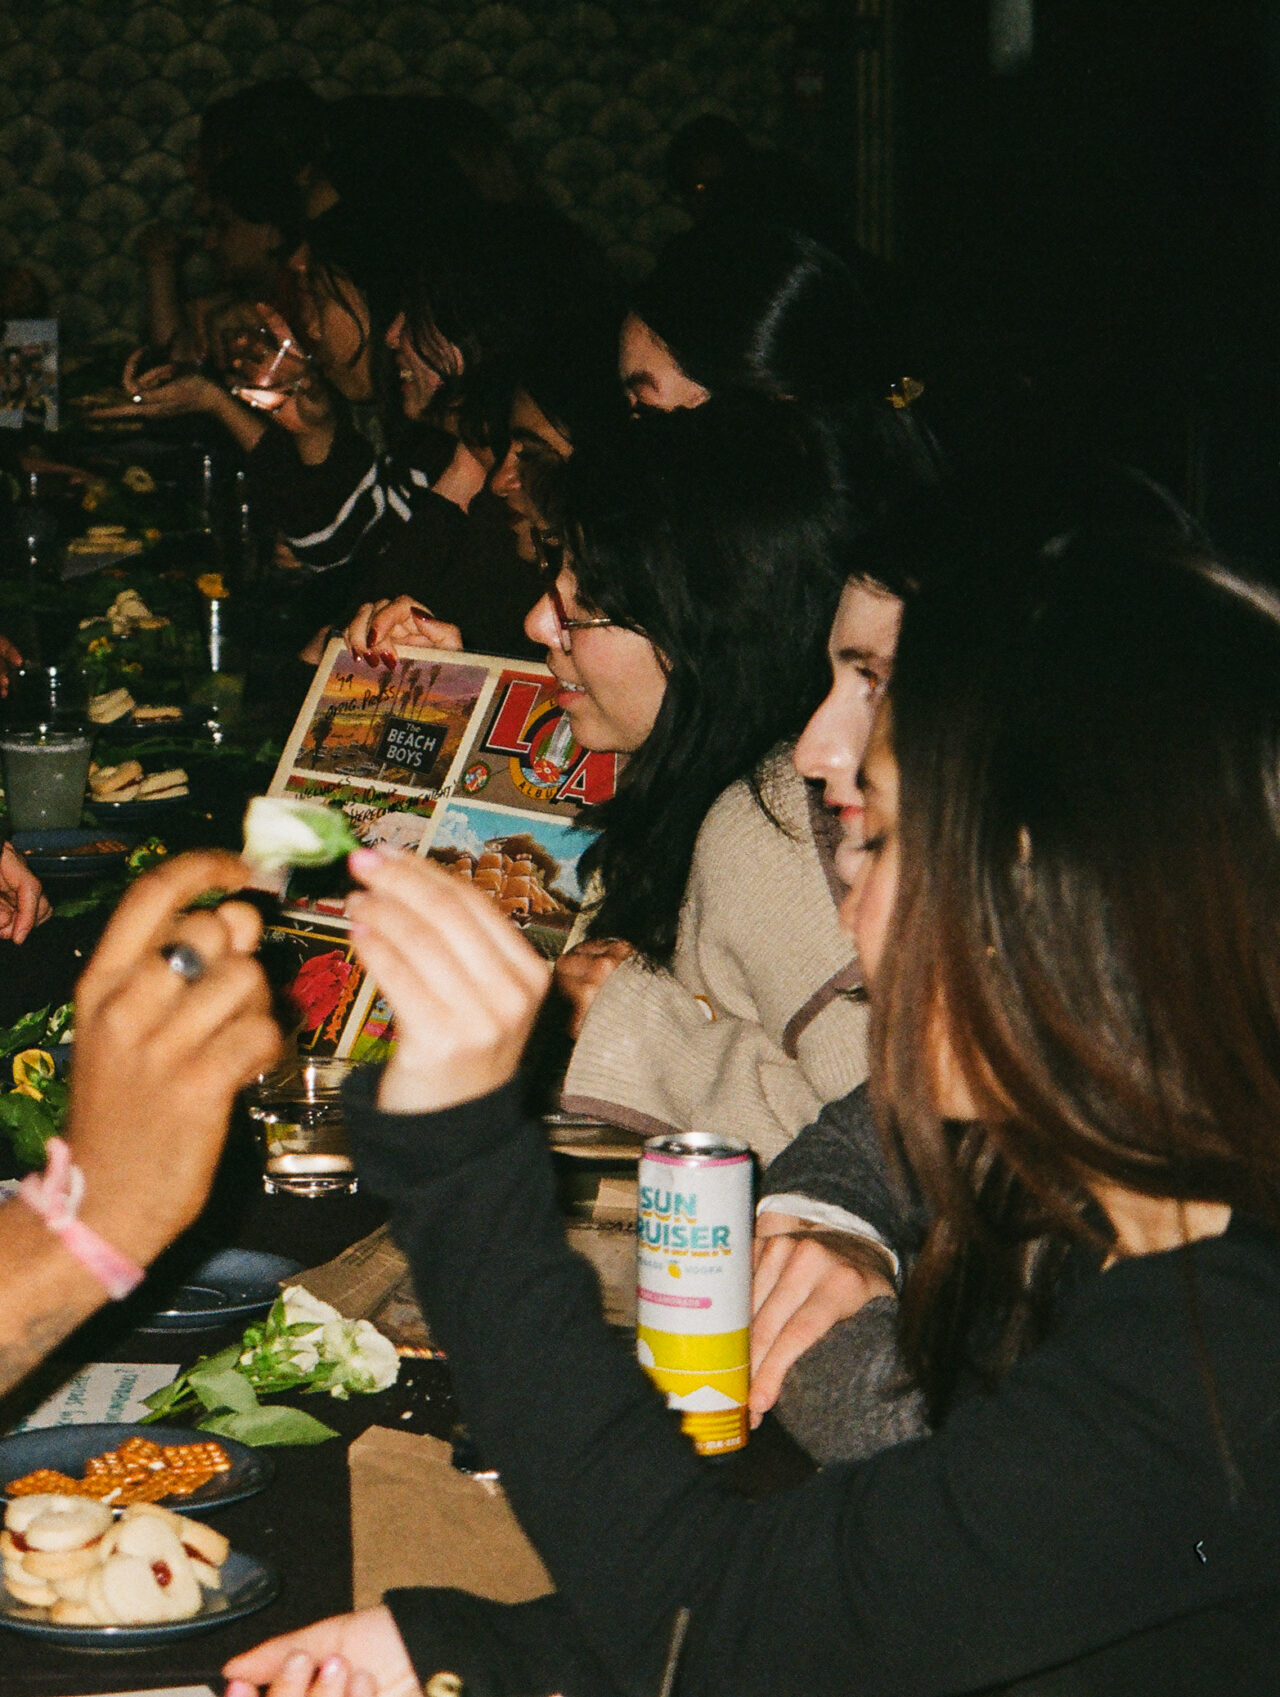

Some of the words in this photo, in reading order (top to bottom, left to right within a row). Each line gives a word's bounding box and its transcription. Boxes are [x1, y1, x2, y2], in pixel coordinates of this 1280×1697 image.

[406, 722, 422, 733] The
[387, 728, 437, 752] BEACH
[386, 744, 424, 768] BOYS
[517, 781, 558, 798] ALBU
[640, 1186, 697, 1217] SUN
[637, 1216, 732, 1250] RUISER
